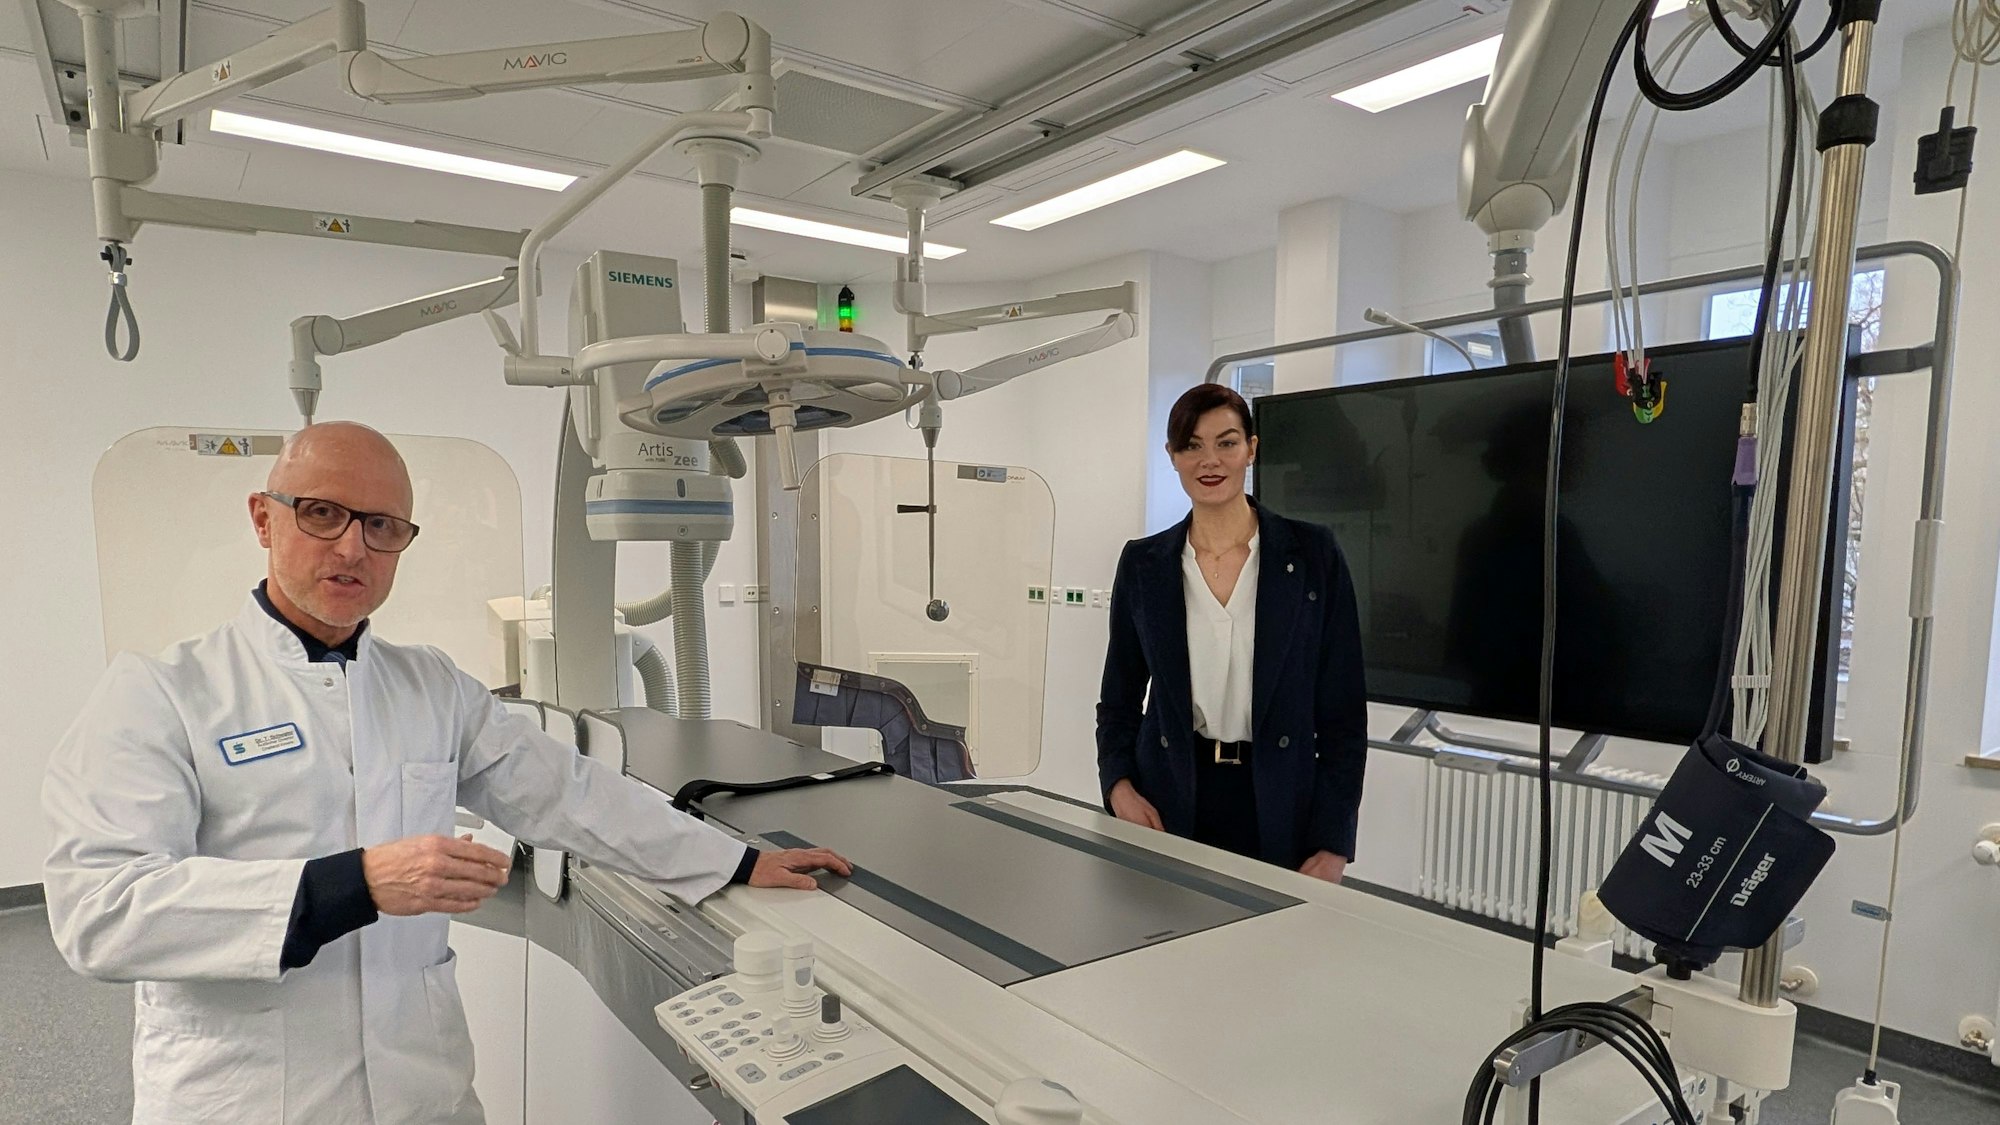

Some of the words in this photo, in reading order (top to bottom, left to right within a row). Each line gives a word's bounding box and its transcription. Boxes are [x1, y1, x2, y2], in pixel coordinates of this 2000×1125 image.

[503, 52, 567, 70] MAVIG
[608, 271, 673, 288] SIEMENS
[638, 442, 673, 457] Artis
[674, 455, 699, 467] zee
[1735, 771, 1767, 786] ARTERY
[1640, 810, 1694, 868] M
[1686, 855, 1714, 889] 23-33
[1709, 836, 1727, 855] cm
[1730, 852, 1776, 907] Dräger
